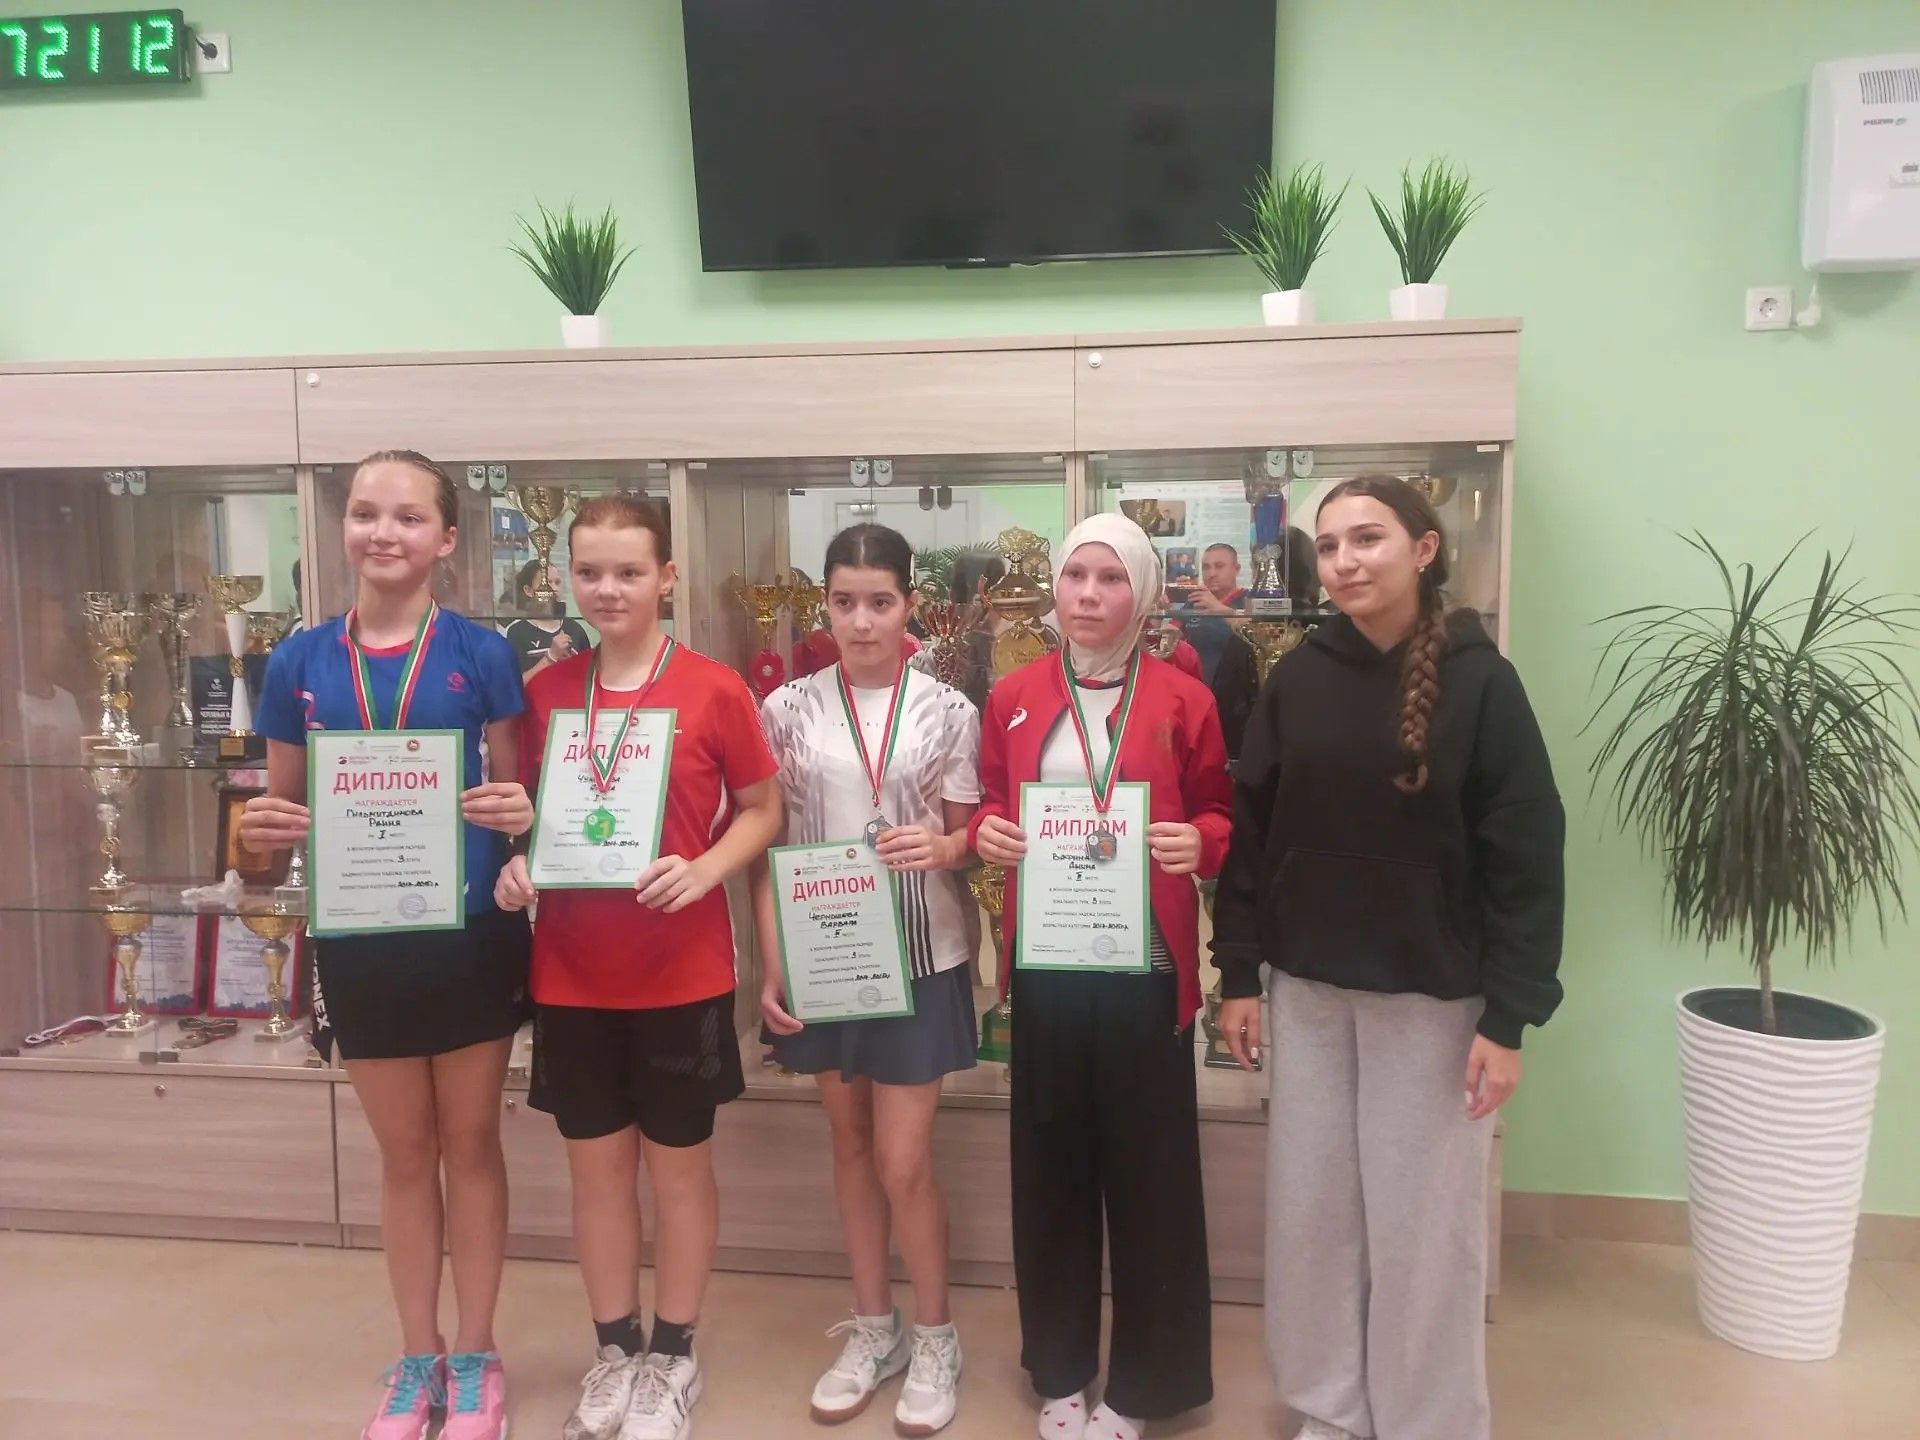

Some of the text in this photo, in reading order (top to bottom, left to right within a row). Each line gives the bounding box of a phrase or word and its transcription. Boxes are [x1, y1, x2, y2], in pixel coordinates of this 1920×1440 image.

[564, 744, 650, 762] ДИПОМ
[333, 771, 438, 794] ДИПЛОМ
[355, 799, 417, 807] НАГРАЖДАЕТСЯ
[1040, 820, 1126, 840] ДИПЛОМ
[793, 875, 876, 902] ДИПЛОМ
[812, 902, 861, 912] НАГРАЖДАЕТСЯ
